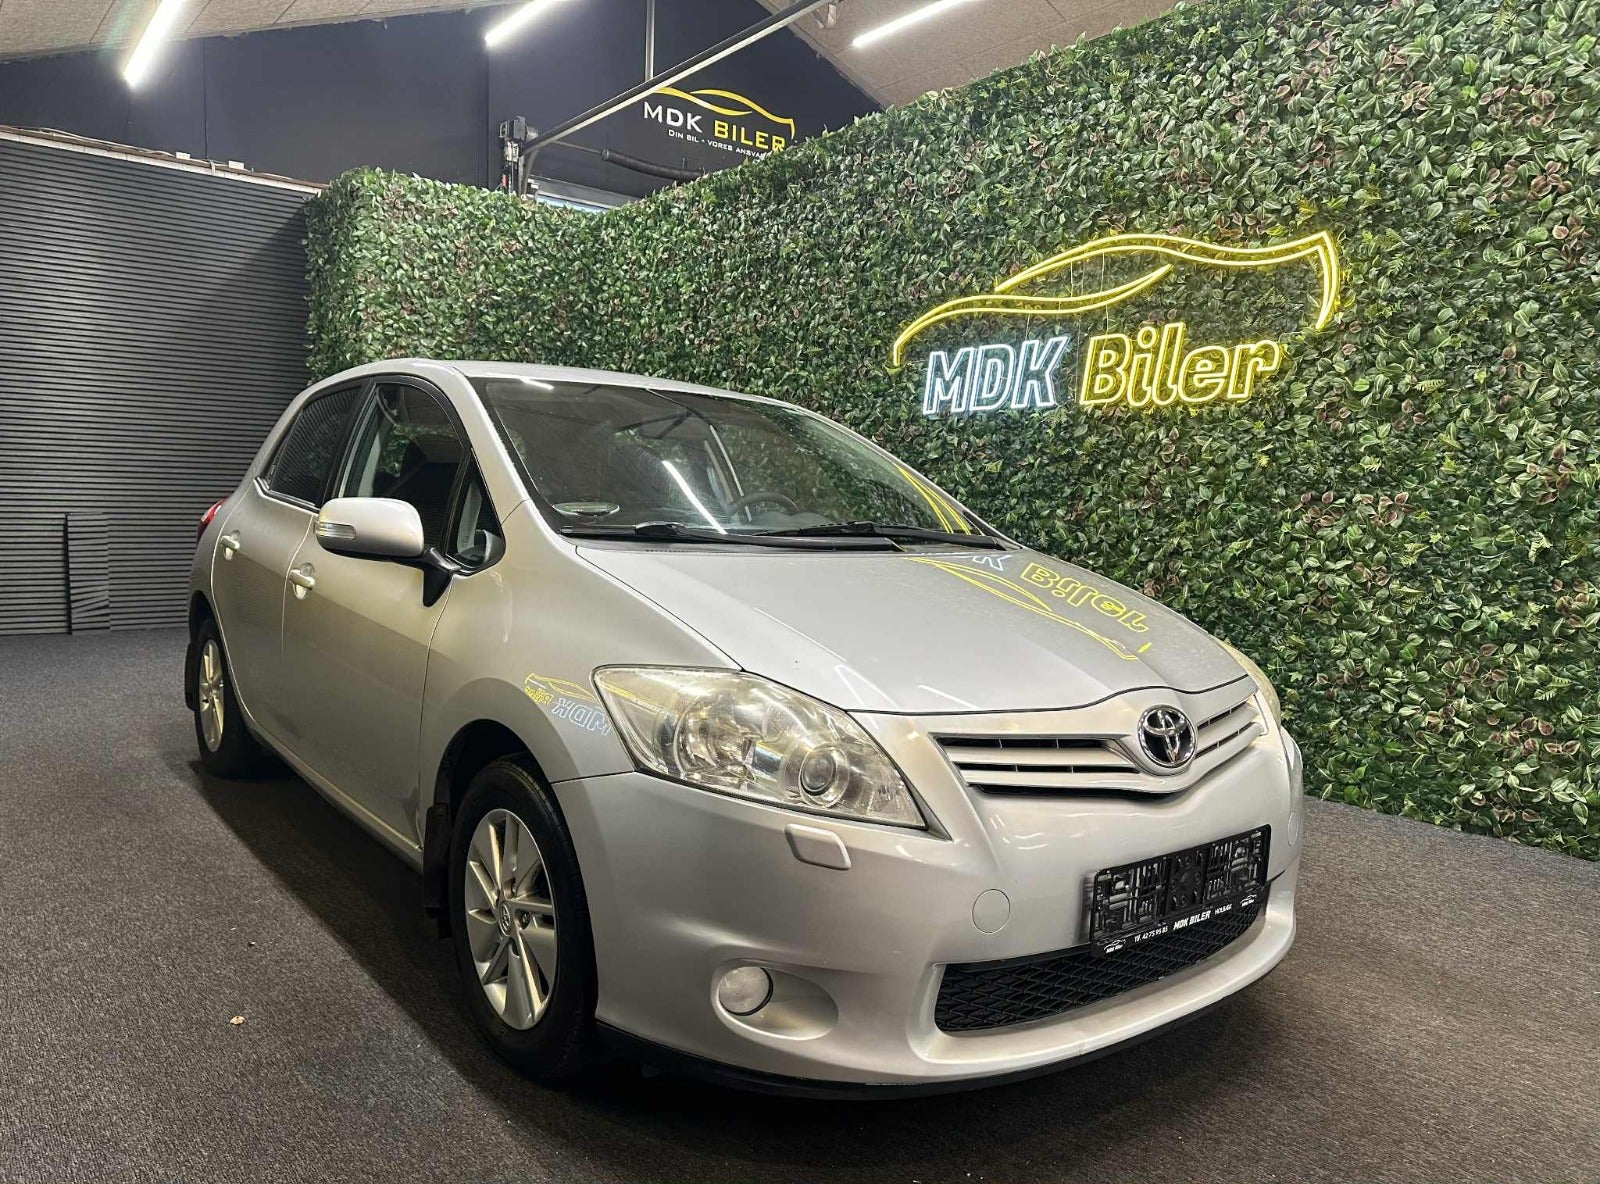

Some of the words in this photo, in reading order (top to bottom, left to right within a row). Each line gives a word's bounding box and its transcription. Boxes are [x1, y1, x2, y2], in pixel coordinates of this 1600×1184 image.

[643, 101, 703, 133] MDK
[713, 119, 786, 152] BILER
[668, 129, 684, 141] DIN
[686, 134, 699, 143] BIL
[922, 335, 1068, 416] MDK
[1079, 321, 1284, 408] Biler
[1189, 910, 1212, 926] BILER
